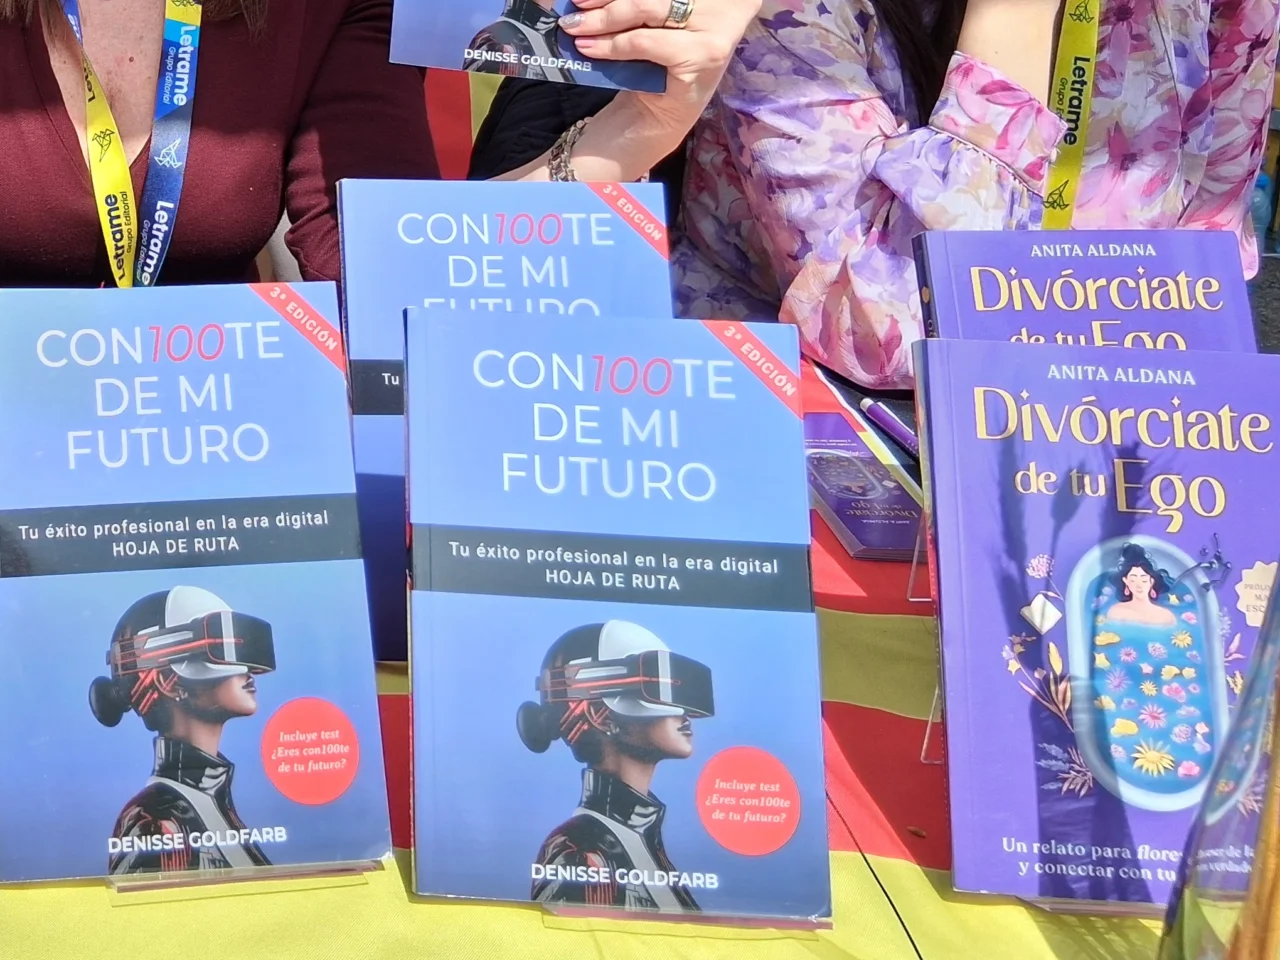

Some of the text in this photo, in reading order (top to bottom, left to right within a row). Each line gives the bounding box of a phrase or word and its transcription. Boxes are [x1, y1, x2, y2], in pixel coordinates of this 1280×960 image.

[162, 46, 176, 104] Grupo Editorial
[173, 25, 197, 107] Letrame
[464, 48, 592, 72] DENISSE GOLDFARB
[1056, 77, 1068, 107] Grupo
[1064, 56, 1091, 145] Letrame
[104, 193, 126, 281] Letrame
[123, 190, 134, 254] Grupo Editorial
[140, 219, 151, 249] Grupo
[397, 212, 615, 246] CON100TE
[616, 197, 662, 242] EDICIÓN
[141, 200, 175, 287] Letrame
[1031, 243, 1156, 258] ANITA ALDANA
[970, 265, 1223, 312] Divórciate
[36, 321, 284, 368] CON100TE
[284, 301, 339, 351] EDICIÓN
[472, 349, 736, 399] CON100TE
[739, 340, 796, 397] EDICIÓN
[1048, 364, 1196, 386] ANITA ALDANA
[95, 373, 232, 418] DE MI
[532, 403, 679, 448] DE MI
[973, 386, 1274, 454] Divórciate
[67, 423, 270, 470] FUTURO
[502, 452, 717, 502] FUTURO
[1015, 458, 1227, 533] de tu Ego
[448, 541, 778, 576] Tu éxito profesional en la era digital
[545, 569, 680, 591] HOJA DE RUTA
[705, 793, 790, 809] ¿Eres con100te
[715, 778, 780, 793] Incluye test
[712, 809, 786, 825] de tu futuro?
[1002, 837, 1027, 853] Un
[1033, 839, 1086, 856] relato
[1091, 843, 1131, 860] para
[531, 863, 719, 889] DENISSE GOLDFARB
[1018, 861, 1176, 882] y conectar con tu
